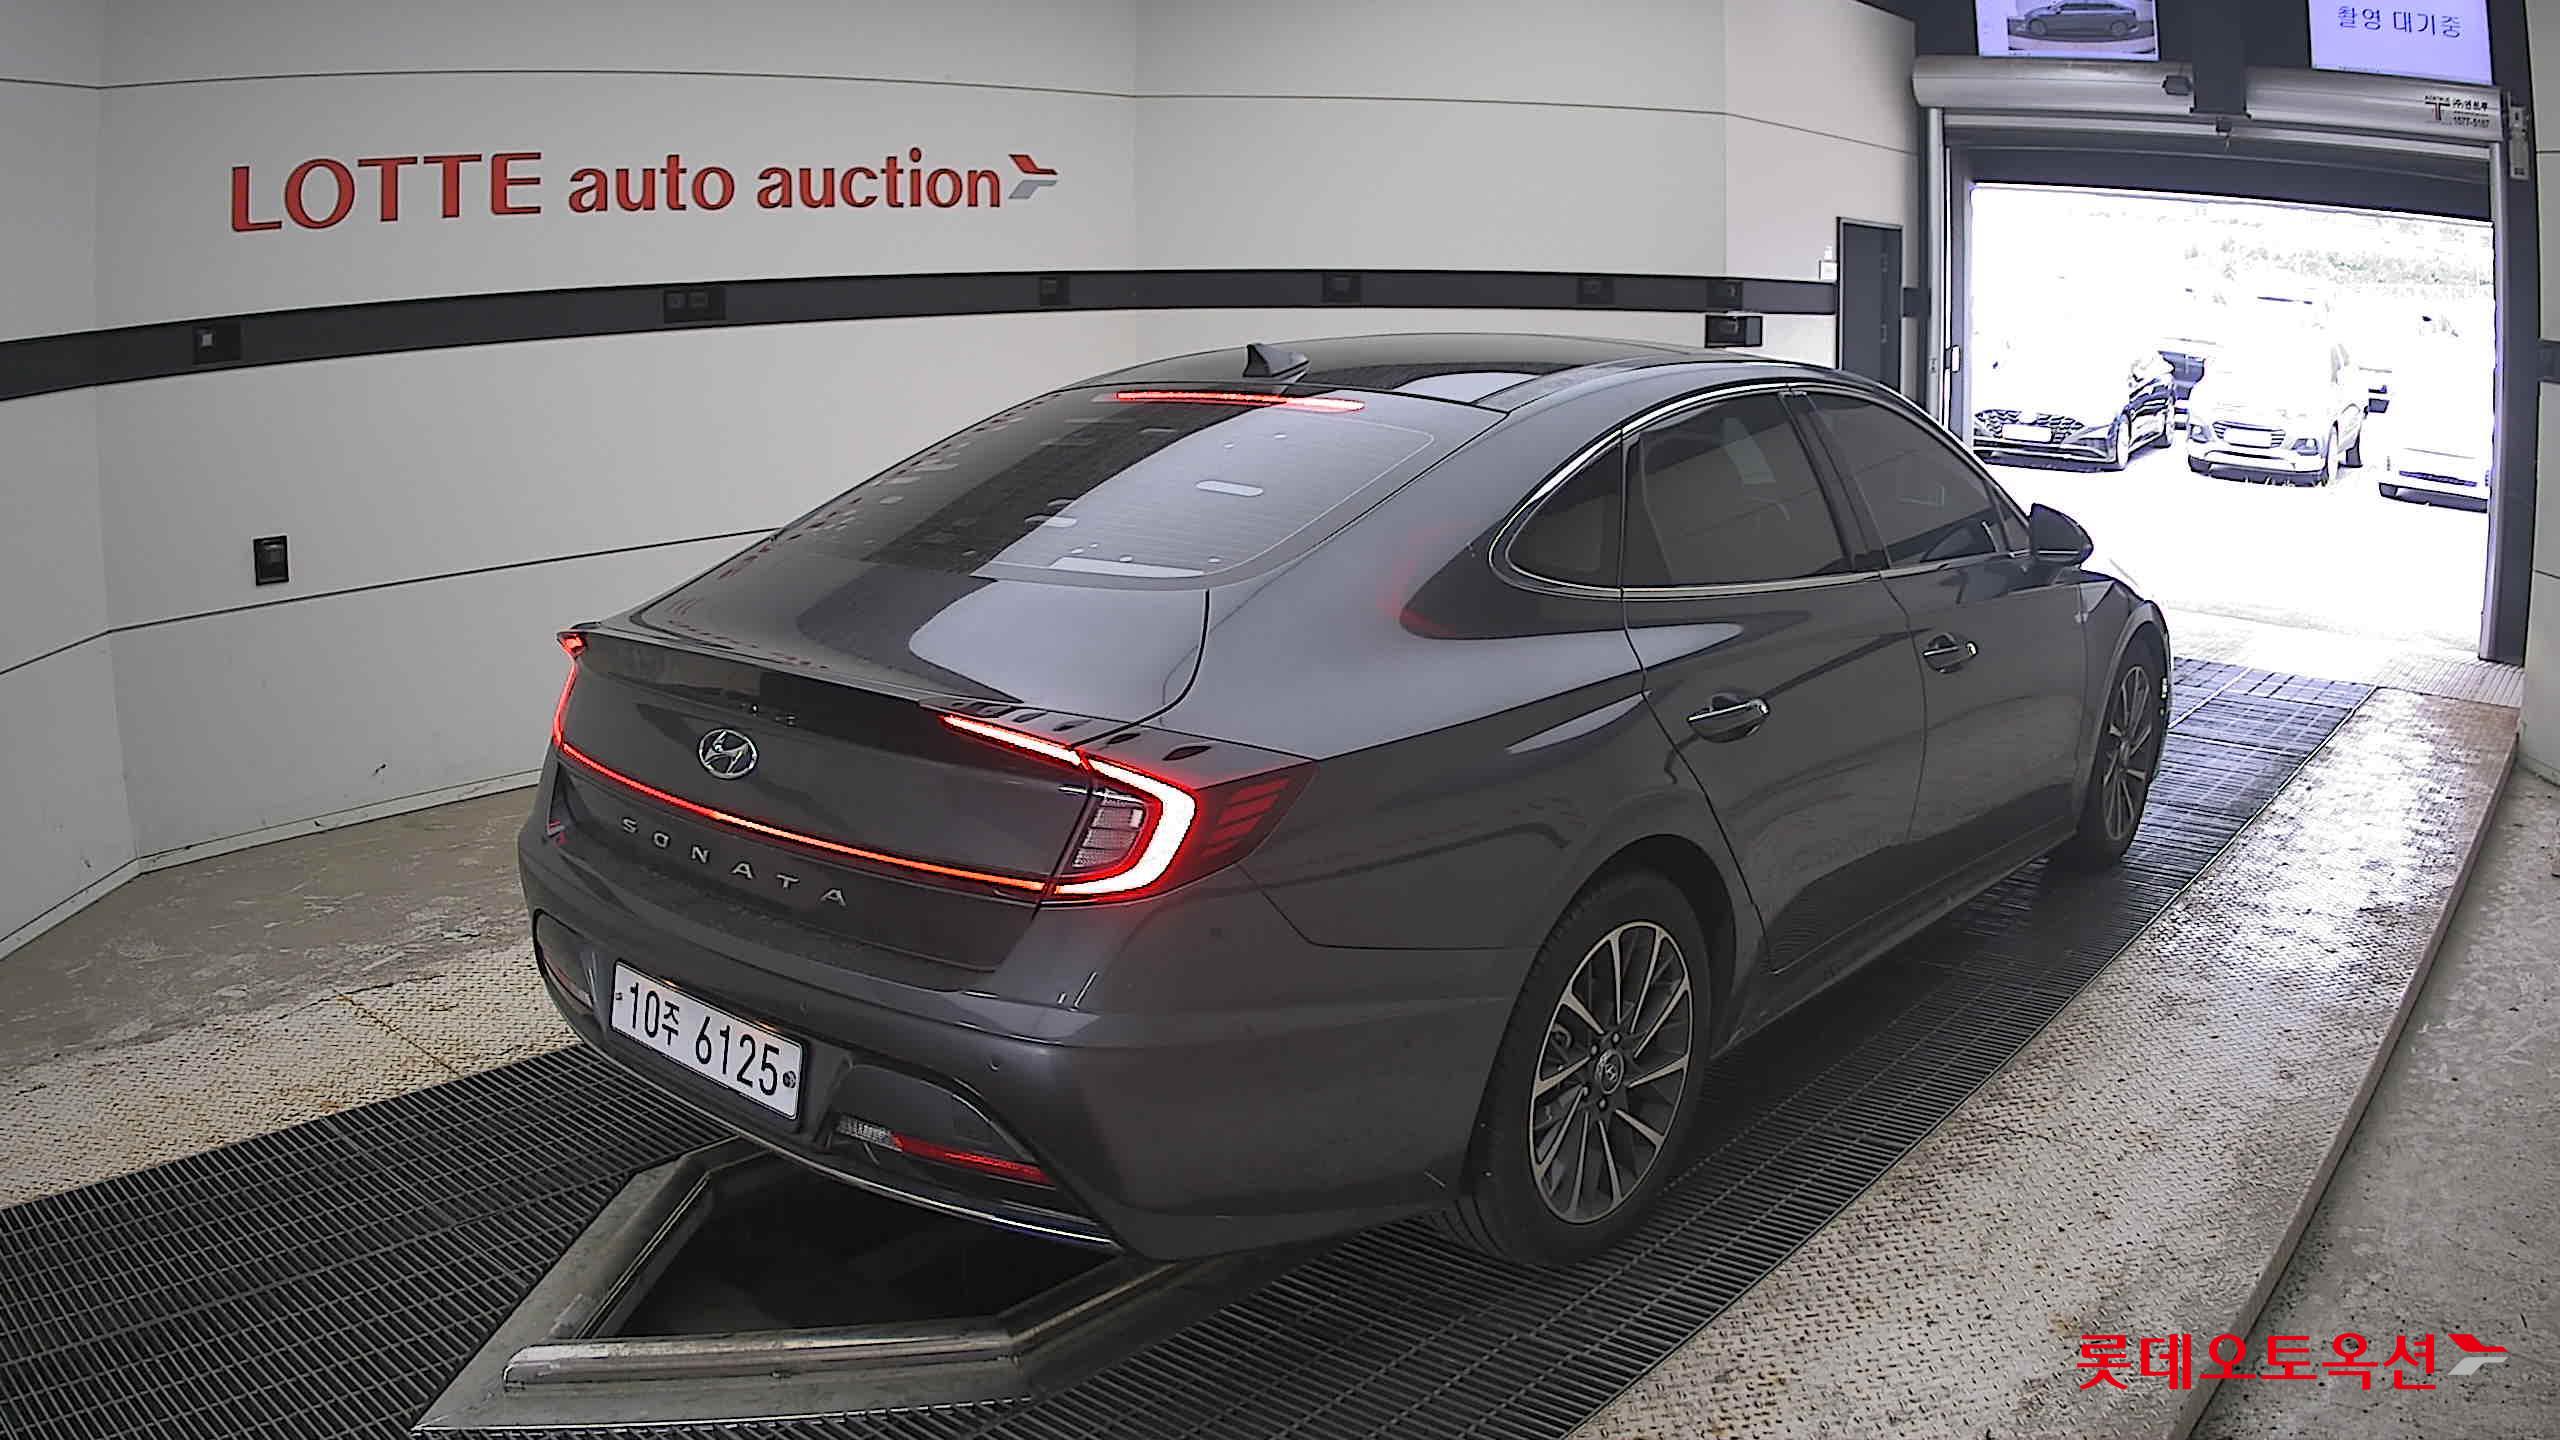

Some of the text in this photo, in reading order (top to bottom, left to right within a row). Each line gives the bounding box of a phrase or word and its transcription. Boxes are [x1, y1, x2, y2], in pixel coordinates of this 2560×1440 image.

[2338, 6, 2463, 39] 촬영 대기중
[231, 147, 1002, 232] LOTTE auto auction
[621, 817, 848, 906] SONATA
[630, 982, 780, 1096] 10주 6125
